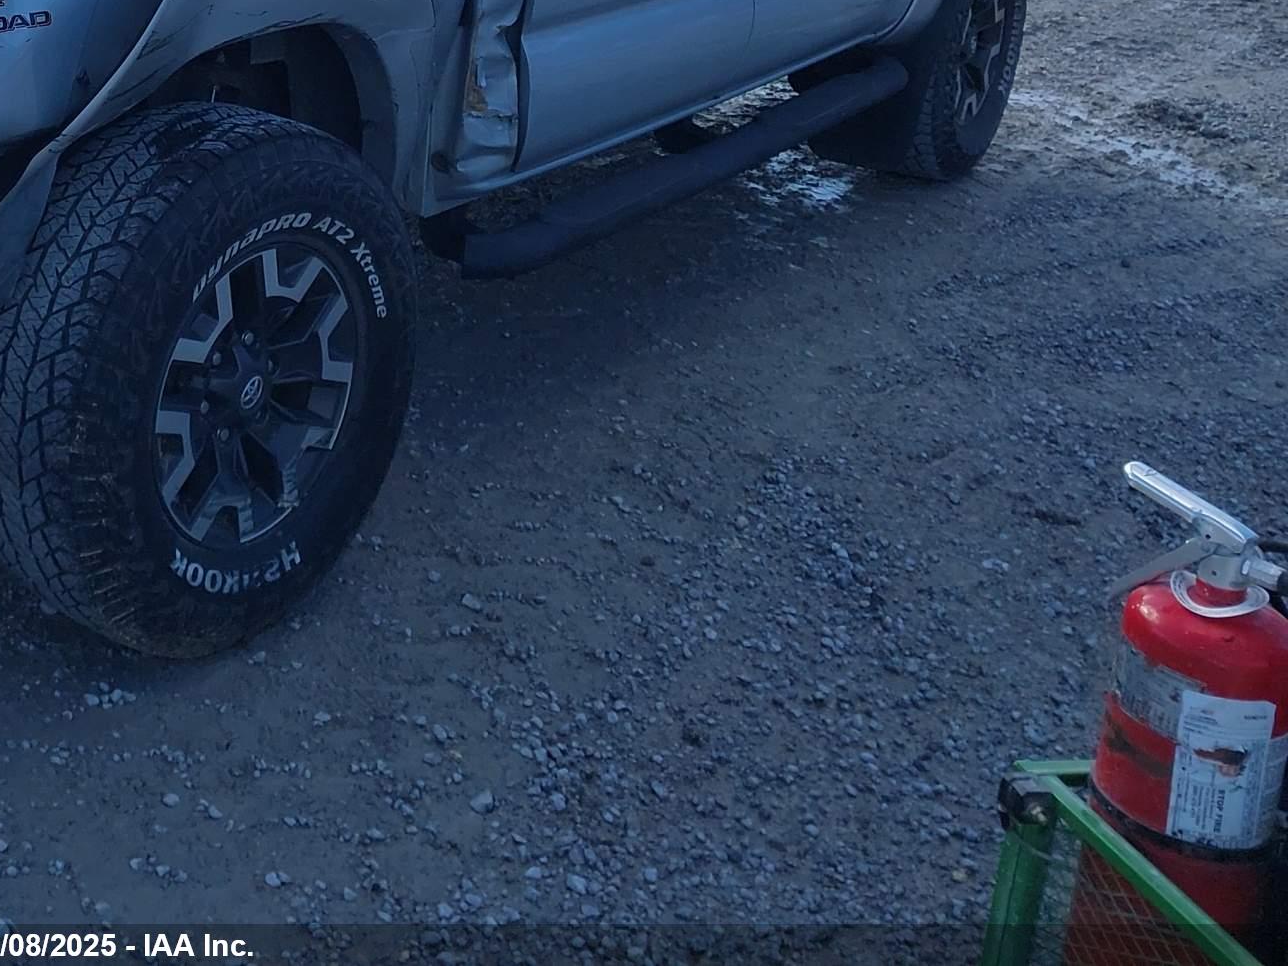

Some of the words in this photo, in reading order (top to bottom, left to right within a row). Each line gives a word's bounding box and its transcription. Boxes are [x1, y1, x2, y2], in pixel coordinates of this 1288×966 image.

[312, 216, 355, 244] AT2
[350, 242, 387, 319] Xtreme
[1216, 789, 1226, 812] STOP
